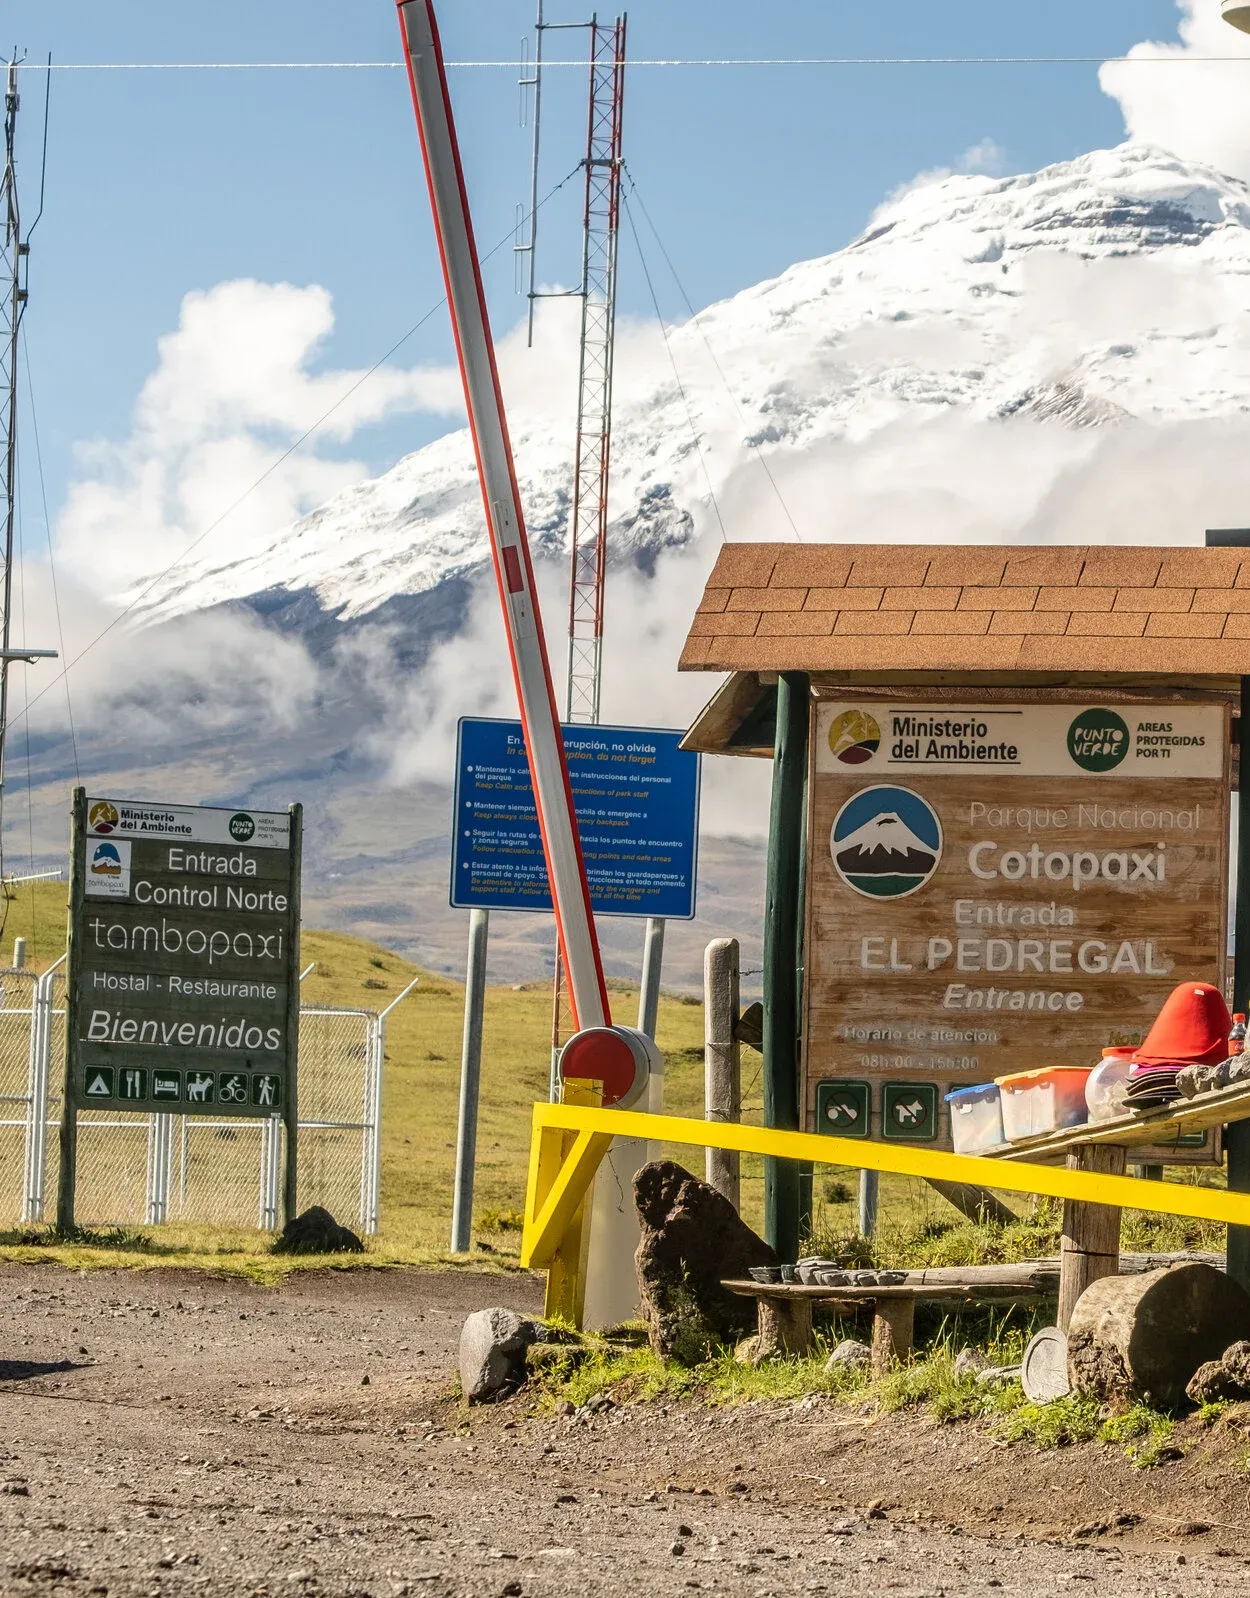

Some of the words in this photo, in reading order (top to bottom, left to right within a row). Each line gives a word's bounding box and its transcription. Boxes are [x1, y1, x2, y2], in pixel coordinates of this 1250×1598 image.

[893, 716, 988, 738] Ministerio
[1074, 726, 1124, 743] PUNTO
[1137, 722, 1173, 733] AREAS
[507, 735, 520, 745] En
[612, 743, 624, 751] no
[627, 743, 656, 753] olvide
[891, 739, 919, 759] del
[925, 740, 1018, 761] Ambiente
[1073, 742, 1120, 757] VERDE
[1136, 735, 1206, 747] PROTEGIDAS
[507, 746, 515, 755] In
[597, 752, 608, 761] do
[611, 754, 626, 762] not
[628, 755, 656, 765] forget
[1136, 747, 1159, 758] POR
[1162, 748, 1171, 759] TI
[475, 765, 507, 773] Mantener
[581, 772, 627, 781] instrucciones
[120, 810, 175, 822] Ministerio
[473, 802, 506, 810] Mantener
[507, 804, 536, 812] siempre
[120, 821, 137, 830] del
[141, 822, 192, 833] Ambiente
[970, 801, 1068, 834] Parque
[1078, 803, 1200, 830] Nacional
[472, 829, 496, 837] Seguir
[648, 839, 683, 848] encuentro
[168, 848, 257, 875] Entrada
[968, 841, 1166, 891] Cotopaxi
[471, 870, 502, 878] personal
[636, 878, 652, 886] todo
[653, 879, 686, 887] momento
[627, 871, 679, 880] guardaparques
[135, 880, 218, 907] Control
[227, 886, 288, 911] Norte
[954, 900, 1075, 926] Entrada
[89, 917, 283, 964] tambopaxi
[860, 936, 913, 971] EL
[927, 938, 1168, 975] PEDREGAL
[93, 971, 150, 991] Hostal
[169, 976, 277, 999] Restaurante
[942, 983, 1084, 1012] Entrance
[87, 1009, 281, 1050] Bienvenidos
[844, 1027, 902, 1040] Horario
[907, 1027, 926, 1040] de
